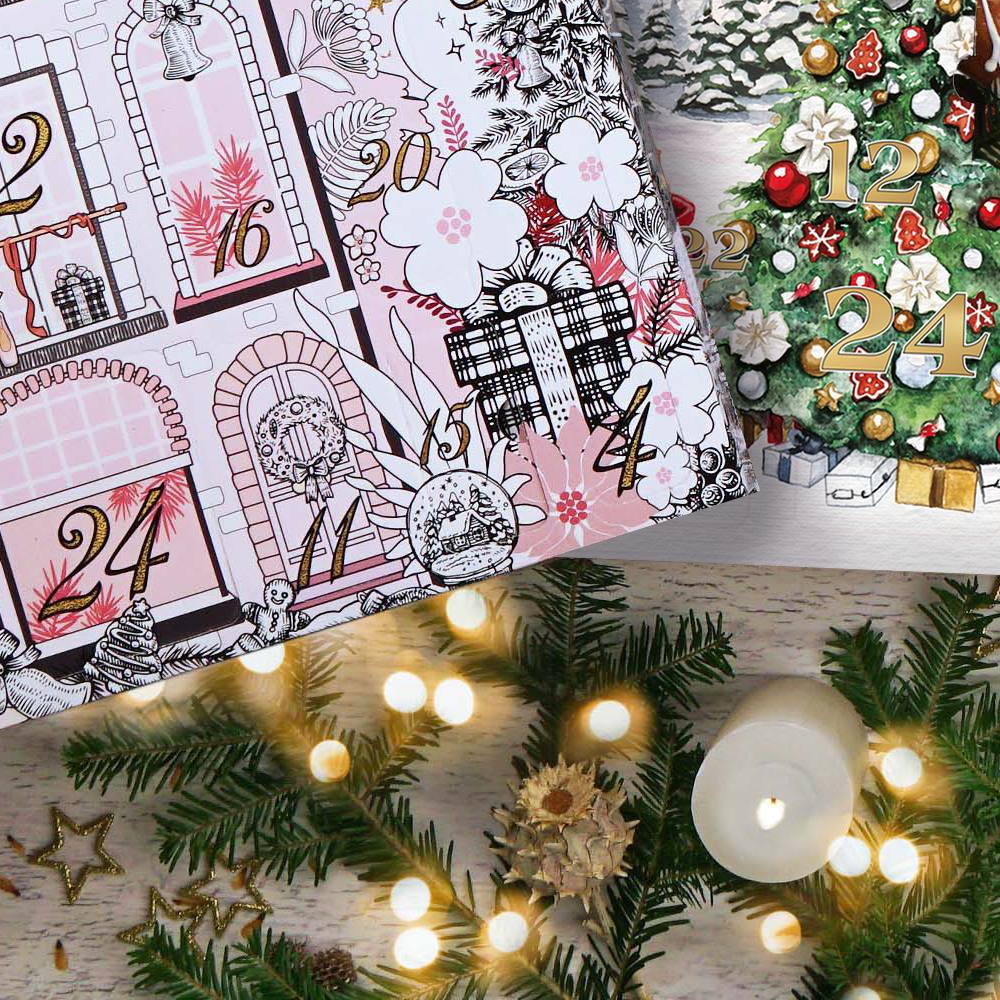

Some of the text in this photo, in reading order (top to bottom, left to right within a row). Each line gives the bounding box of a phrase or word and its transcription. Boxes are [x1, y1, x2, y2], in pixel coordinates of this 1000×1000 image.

[348, 131, 432, 207] 20
[818, 139, 922, 208] 12
[214, 200, 273, 277] 16
[821, 285, 990, 378] 24
[420, 390, 478, 468] 15
[593, 378, 657, 498] 4
[38, 486, 170, 622] 24
[299, 495, 361, 590] 11
